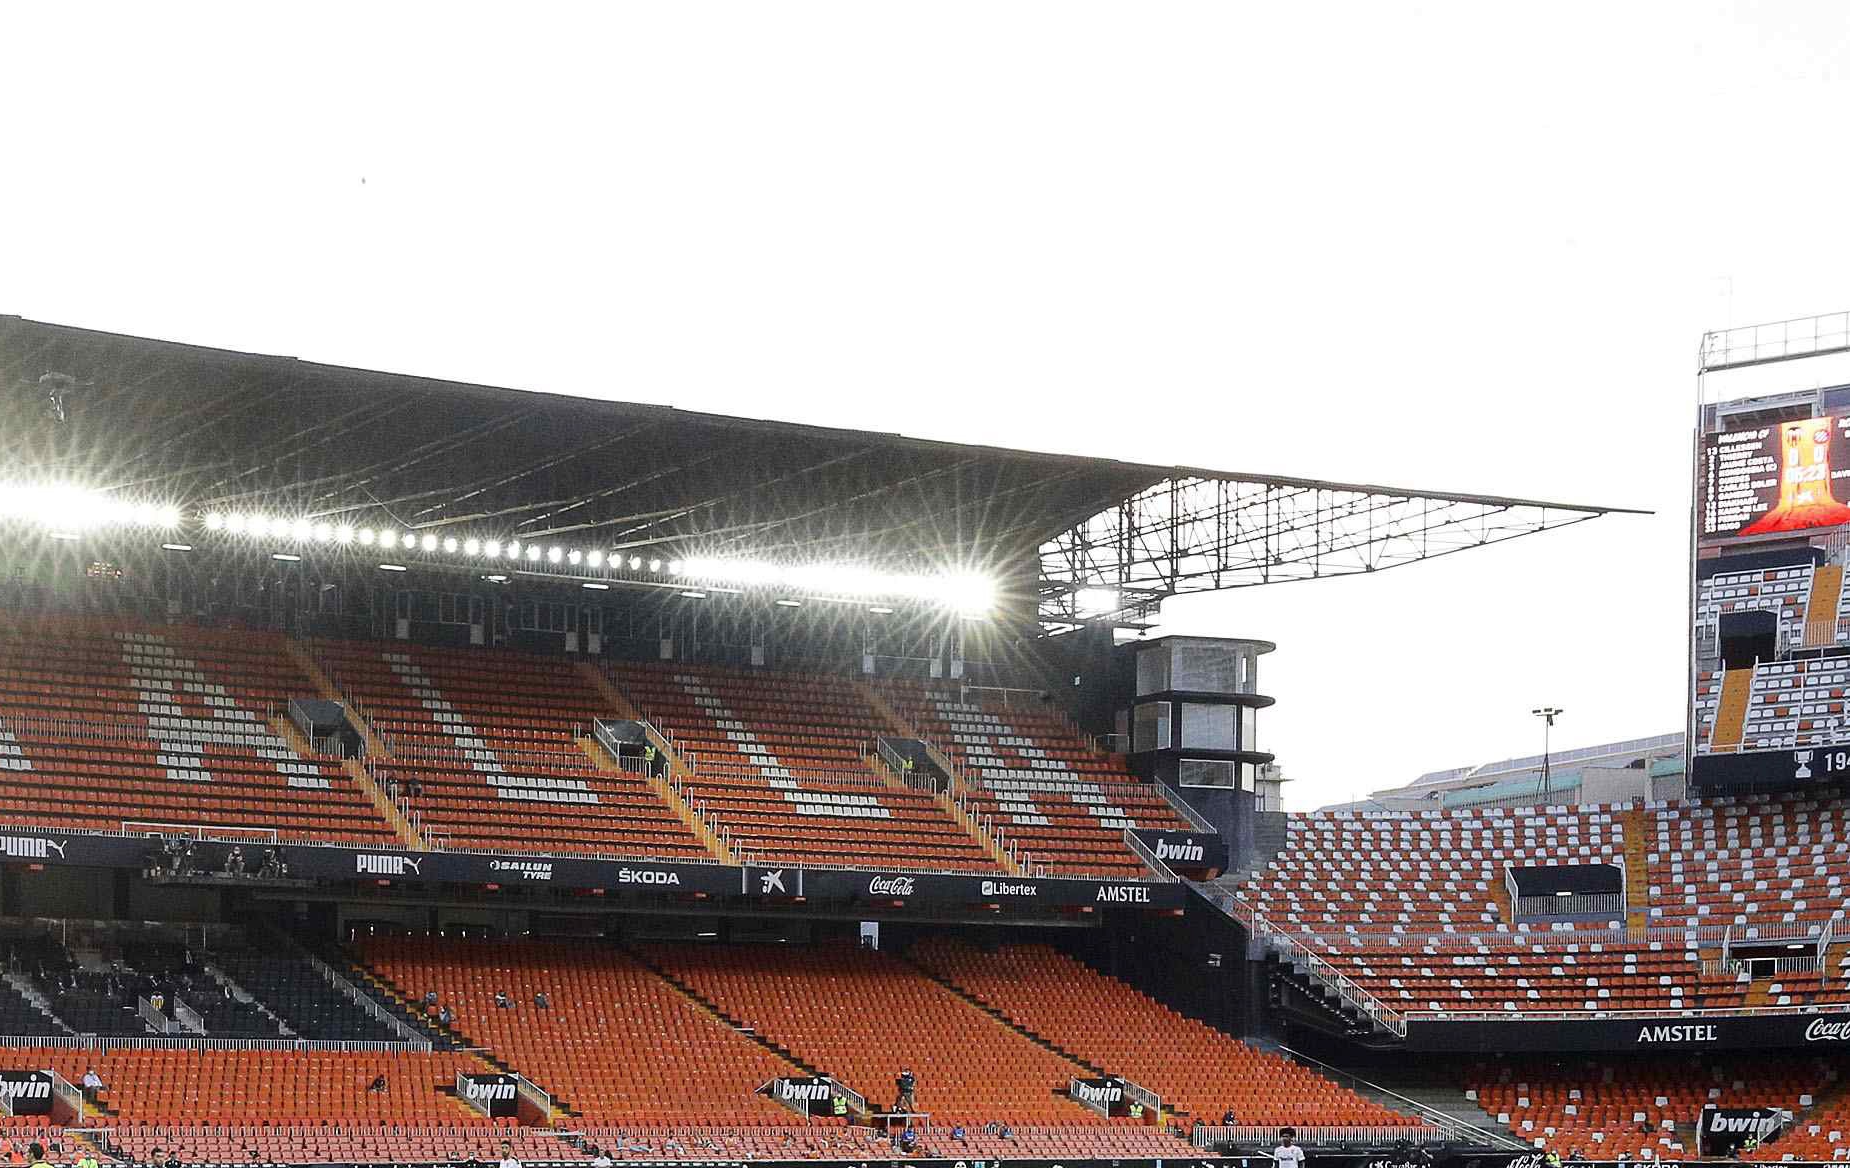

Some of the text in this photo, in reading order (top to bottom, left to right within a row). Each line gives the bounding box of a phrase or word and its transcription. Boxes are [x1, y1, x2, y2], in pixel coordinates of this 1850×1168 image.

[1155, 838, 1204, 862] bwin
[356, 855, 405, 874] PUMA
[500, 862, 552, 872] SAILUN
[522, 871, 552, 880] TYRE
[618, 868, 680, 885] ŠKODA
[869, 876, 915, 896] Coca-Cola
[993, 882, 1037, 896] Libertex
[1096, 885, 1150, 903] AMSTEL
[1637, 1025, 1718, 1042] AMSTEL
[466, 1078, 517, 1100] bwin
[781, 1079, 830, 1100] bwin
[1078, 1082, 1122, 1102] bwin
[1709, 1111, 1775, 1133] bwin
